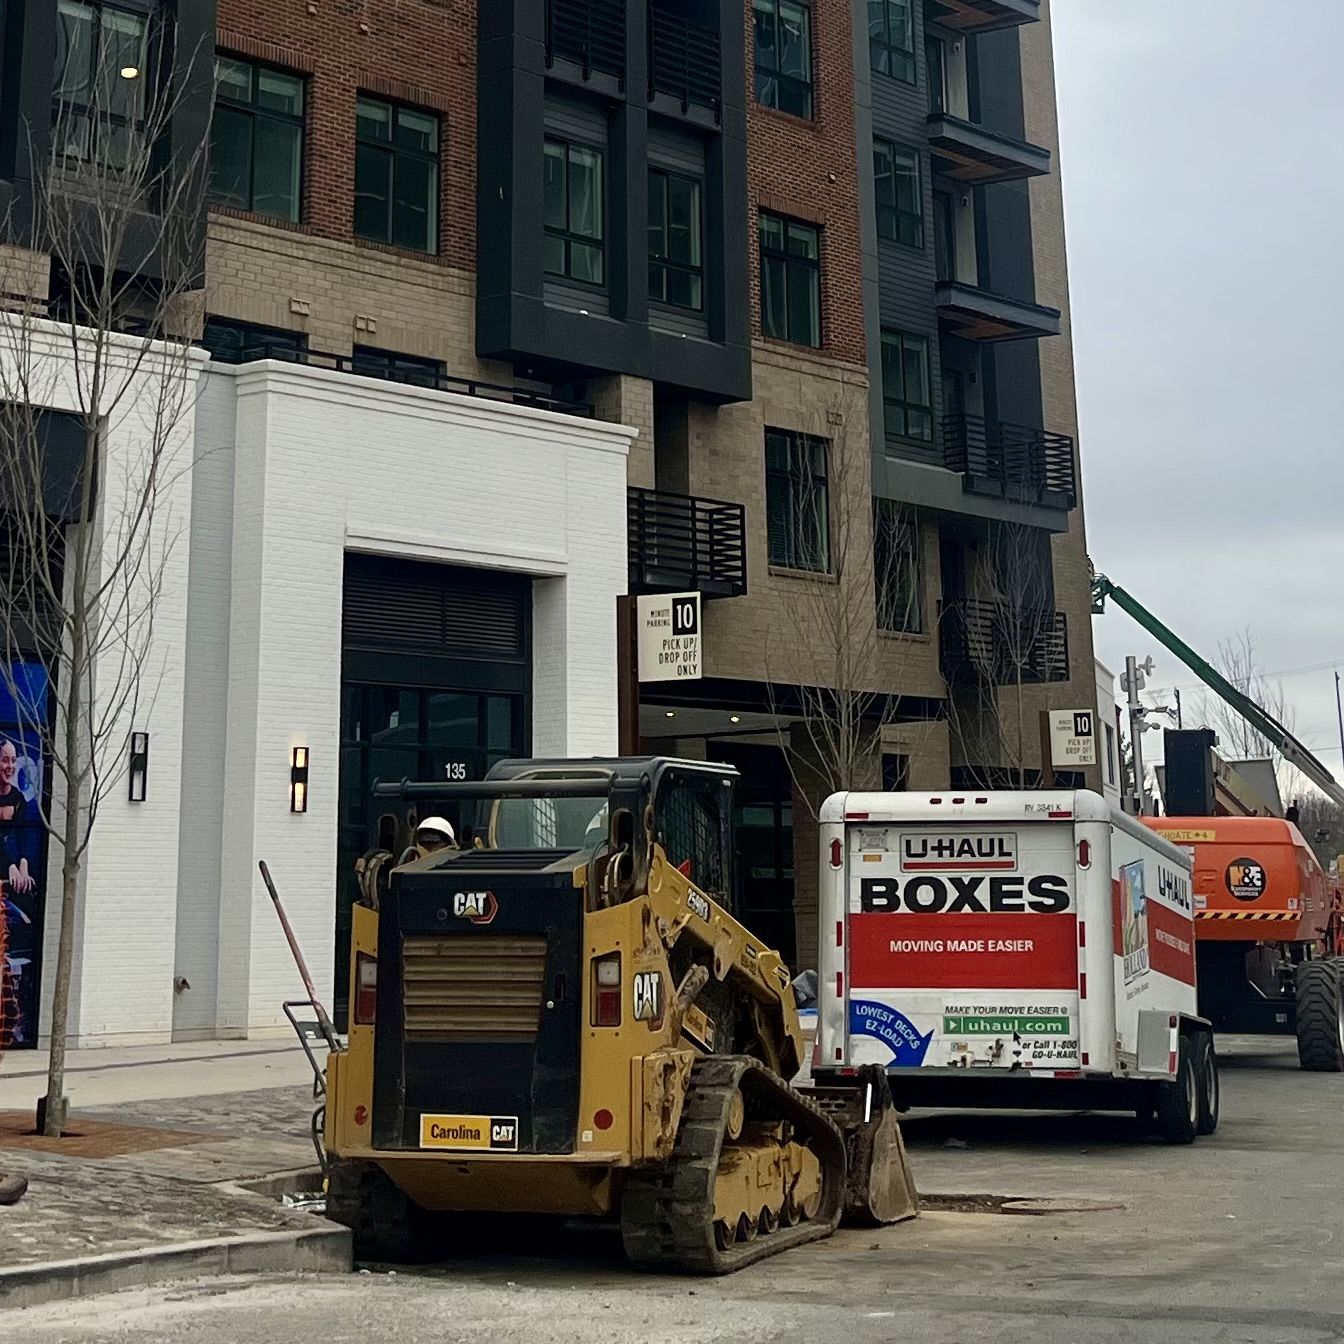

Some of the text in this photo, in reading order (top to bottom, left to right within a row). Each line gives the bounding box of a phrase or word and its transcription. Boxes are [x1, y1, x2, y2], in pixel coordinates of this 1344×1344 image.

[647, 620, 671, 628] PARKING
[677, 603, 694, 629] 10
[663, 639, 681, 651] PICK
[659, 651, 697, 664] DROP OFF
[677, 664, 698, 676] ONLY
[1077, 716, 1089, 733] 10
[445, 762, 466, 780] 135
[905, 837, 1013, 858] U-HAUL
[860, 875, 1070, 913] BOXES
[454, 892, 487, 916] CAT
[890, 940, 1034, 953] MOVING MADE EASIER
[634, 973, 660, 1020] CAT
[945, 1006, 971, 1015] MAKE
[973, 1006, 997, 1015] YOUR
[999, 1006, 1025, 1015] MOVE
[1027, 1006, 1059, 1015] EASIER
[856, 1005, 921, 1049] LOWEST DECKS
[865, 1019, 904, 1047] EZ-LOAD
[968, 1019, 1063, 1032] uhaul.com
[1033, 1040, 1050, 1049] Call
[430, 1123, 514, 1142] Carolina CAT
